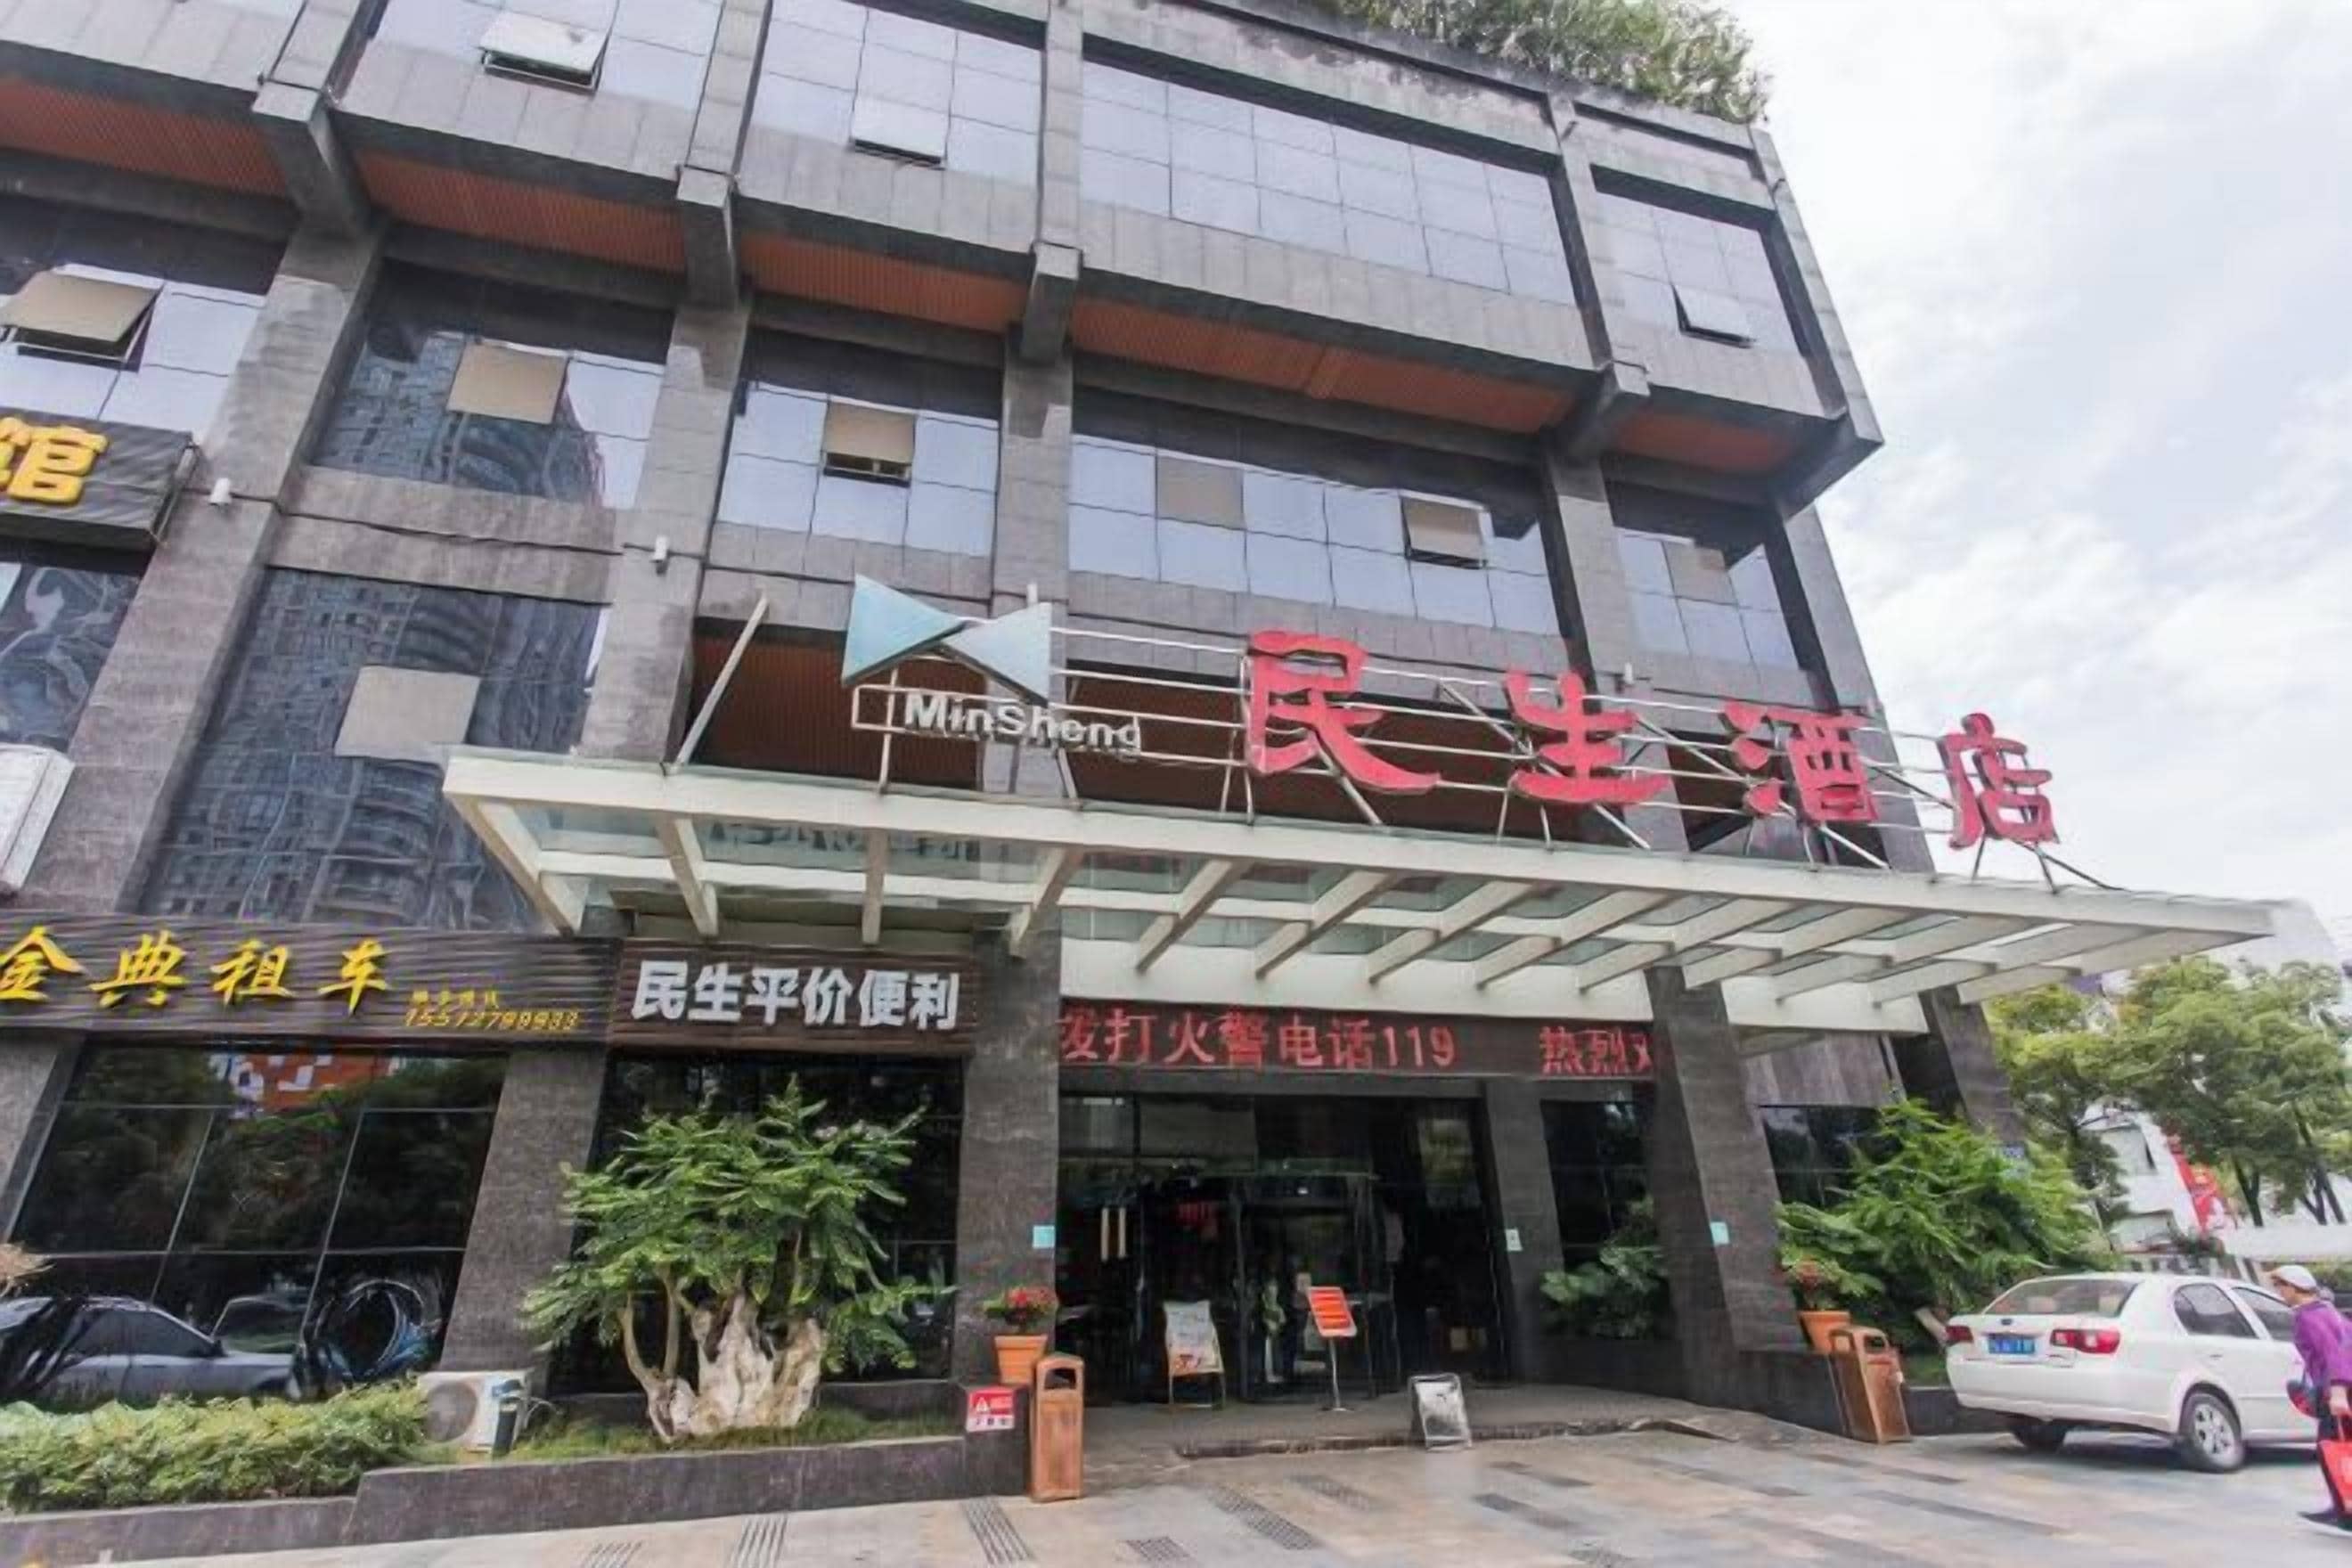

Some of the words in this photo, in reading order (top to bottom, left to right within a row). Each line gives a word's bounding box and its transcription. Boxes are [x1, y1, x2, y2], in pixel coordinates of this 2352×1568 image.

[903, 690, 1141, 761] MinSheng
[1247, 630, 2060, 850] 民生酒店
[0, 926, 393, 1016] 金典租车
[631, 960, 960, 1031] 民生平价便利
